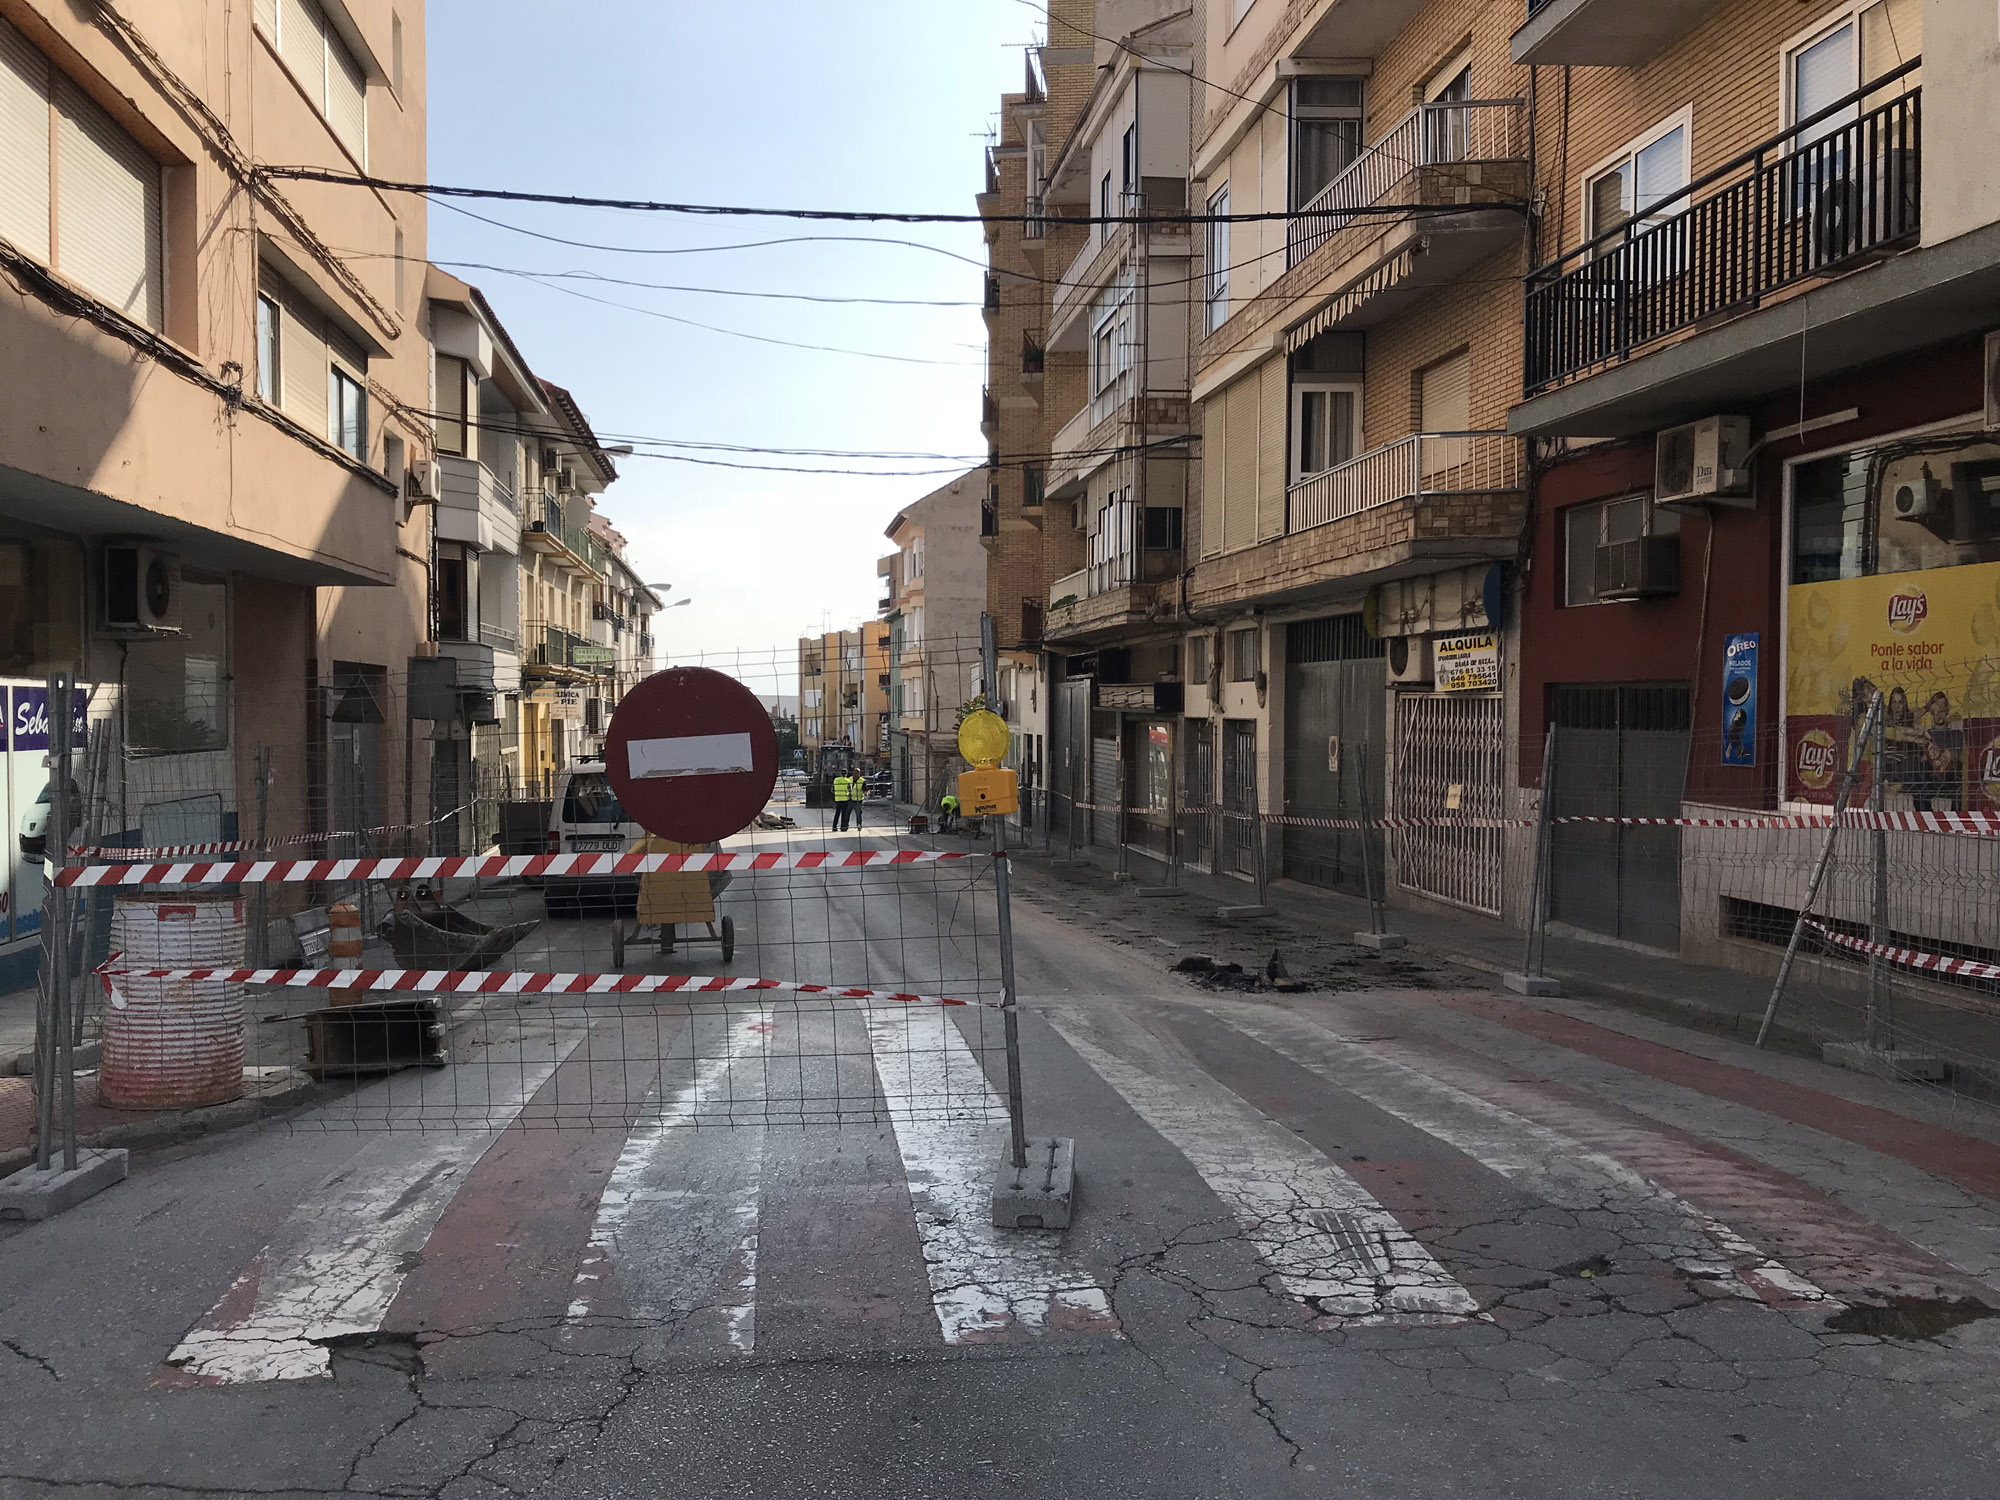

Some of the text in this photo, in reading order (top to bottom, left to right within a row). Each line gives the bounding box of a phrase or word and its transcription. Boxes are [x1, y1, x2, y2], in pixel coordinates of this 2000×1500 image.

[1891, 595, 1924, 624] Lay's
[1440, 636, 1492, 652] ALQUILA
[1727, 640, 1756, 657] OREO
[1871, 640, 1945, 657] Ponle sabor
[1881, 656, 1932, 671] a la vida
[1467, 672, 1496, 680] 795641
[1468, 679, 1497, 687] 703420
[1799, 741, 1835, 777] Lay's
[577, 841, 618, 850] 7779 DLD
